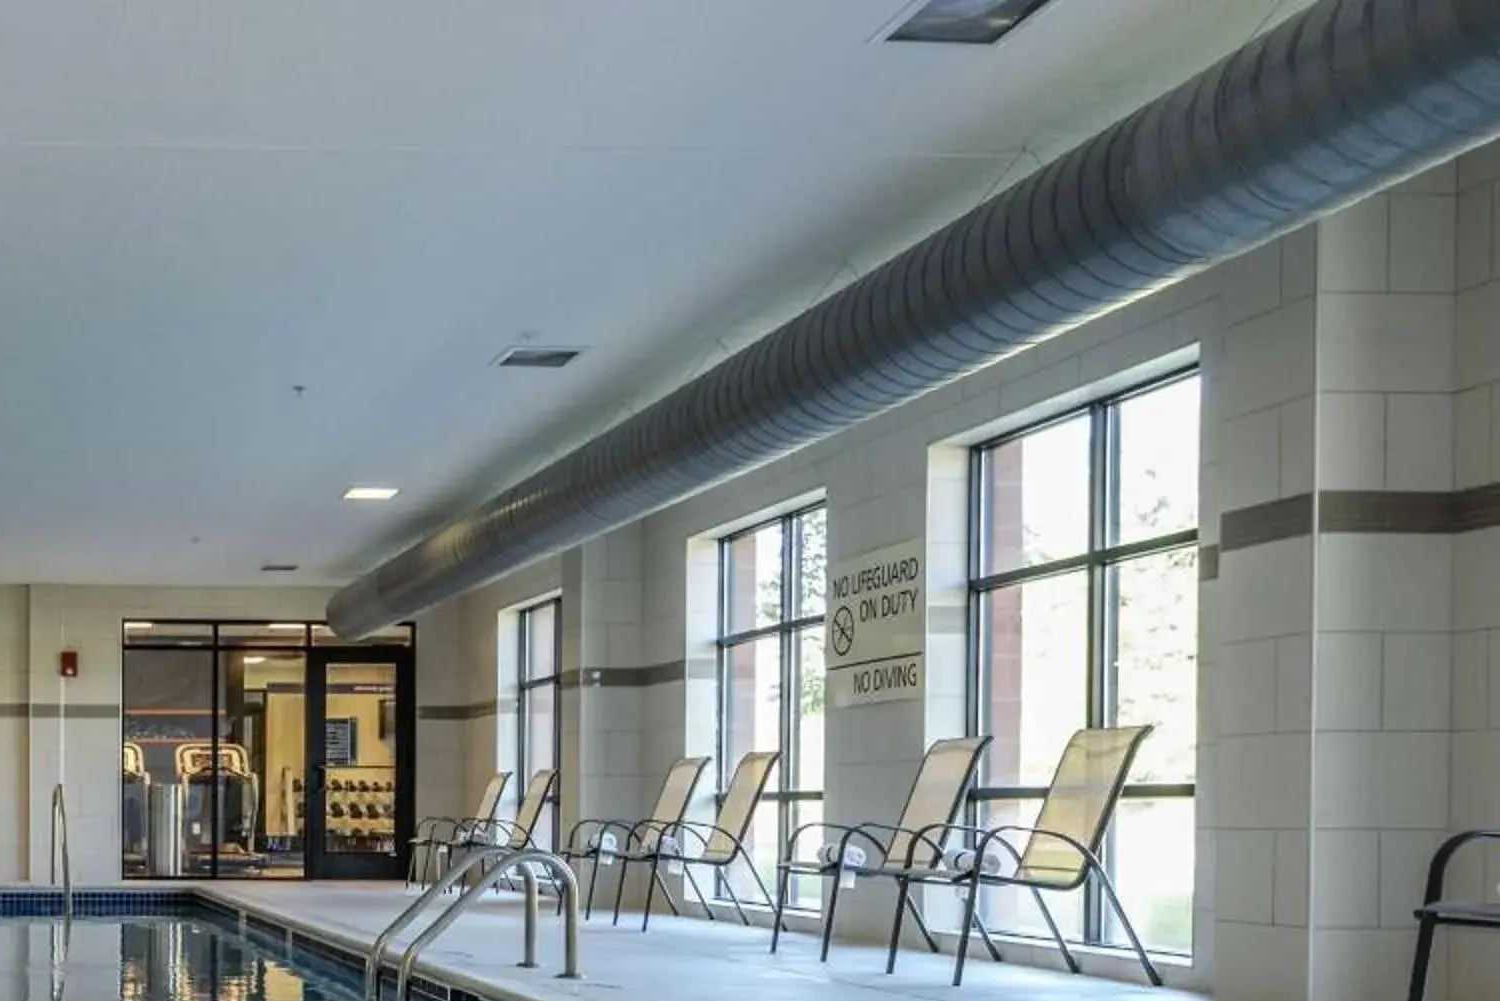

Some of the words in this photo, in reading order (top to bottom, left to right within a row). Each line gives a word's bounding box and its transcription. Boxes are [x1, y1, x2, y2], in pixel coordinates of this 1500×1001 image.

[833, 576, 850, 600] NO
[852, 557, 919, 595] LIFEGUARD
[859, 598, 877, 622] ON
[881, 589, 919, 617] DUTY
[853, 671, 871, 694] NO
[874, 663, 917, 692] DIVING
